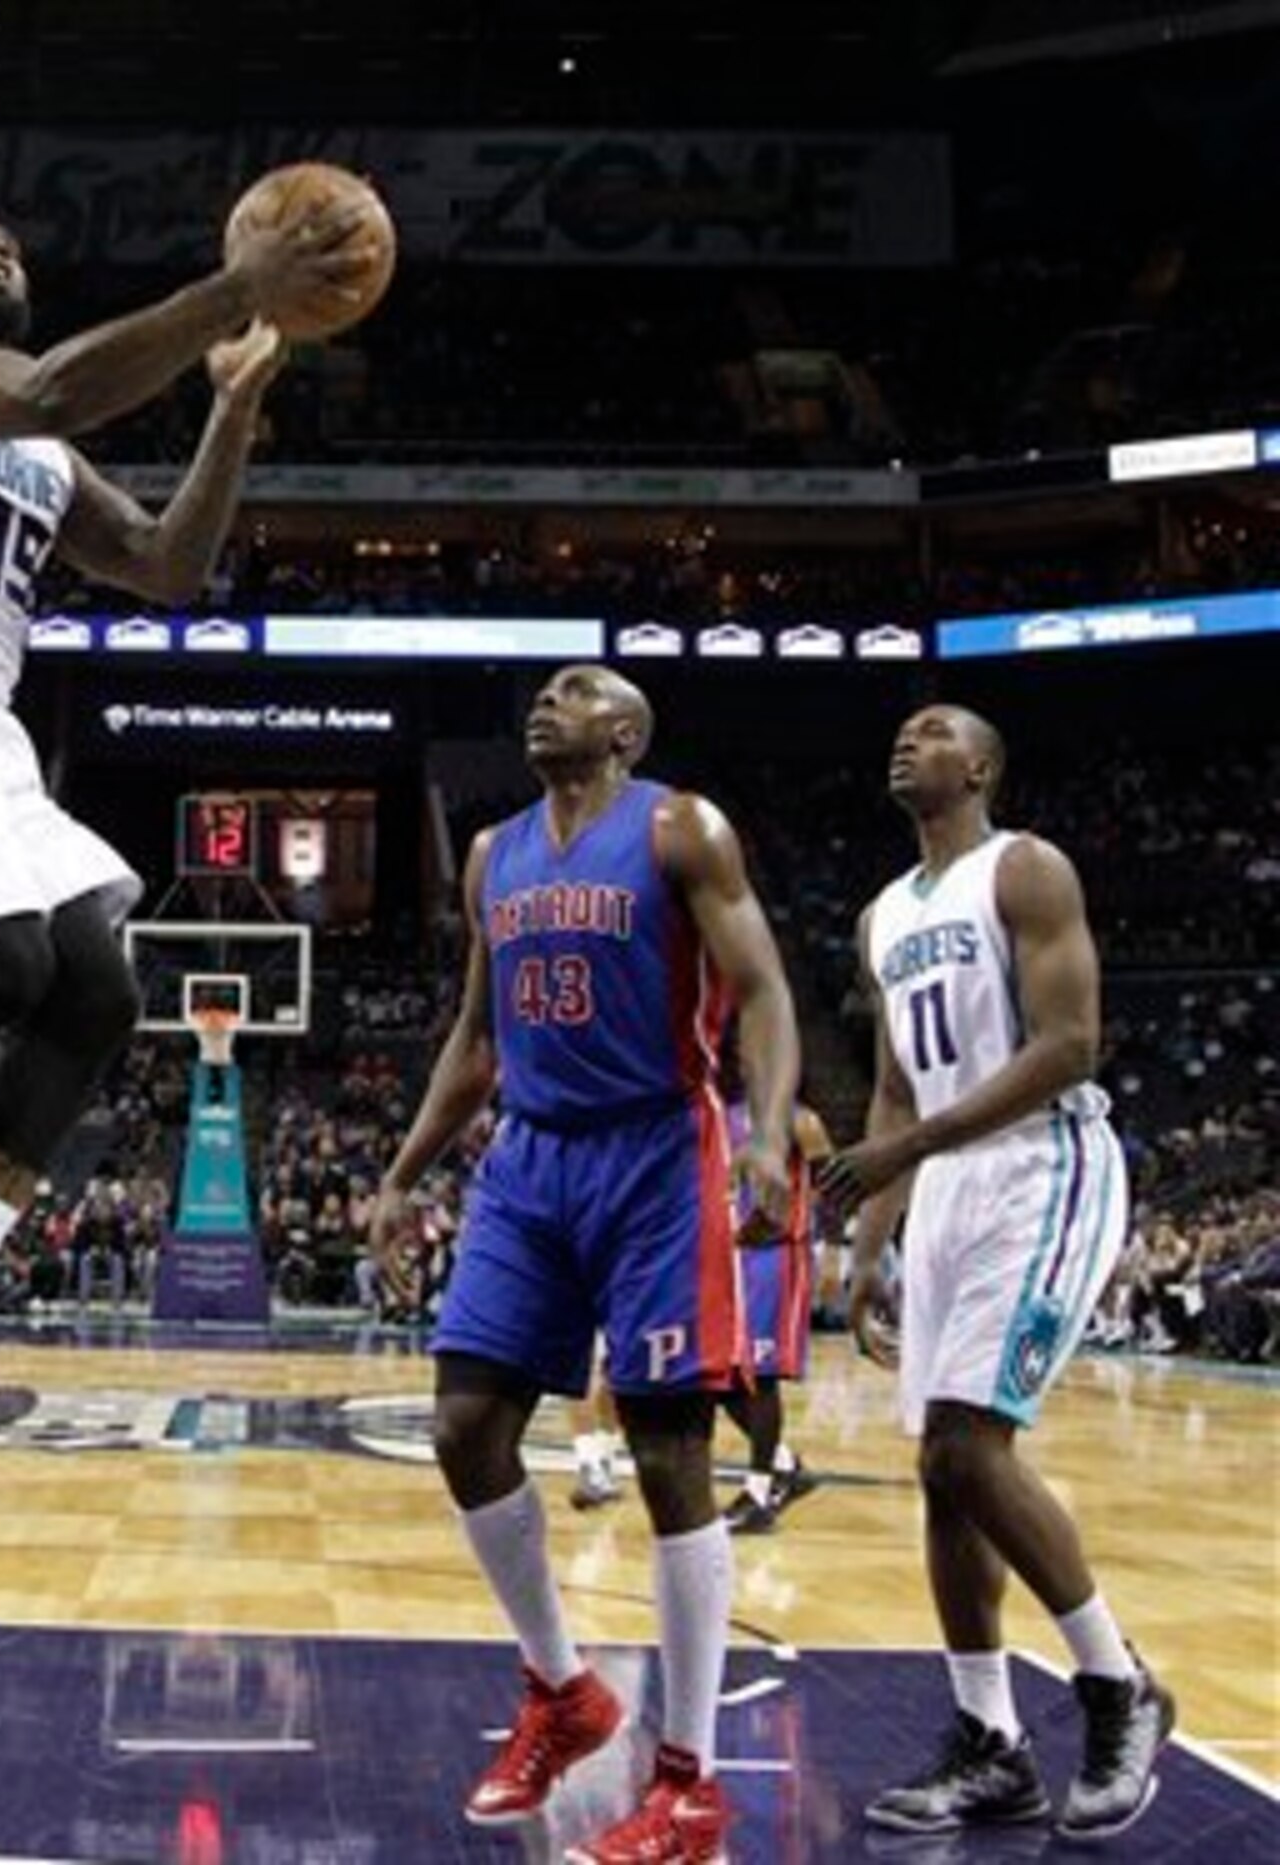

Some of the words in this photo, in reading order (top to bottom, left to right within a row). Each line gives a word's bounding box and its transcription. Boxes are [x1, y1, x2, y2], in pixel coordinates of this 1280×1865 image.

[134, 705, 181, 726] Time
[184, 706, 259, 727] Warner
[264, 706, 320, 728] Cable
[325, 707, 391, 730] Arena
[489, 881, 635, 941] DETROIT
[517, 956, 595, 1025] 43
[910, 981, 958, 1070] 11
[645, 1324, 686, 1380] P
